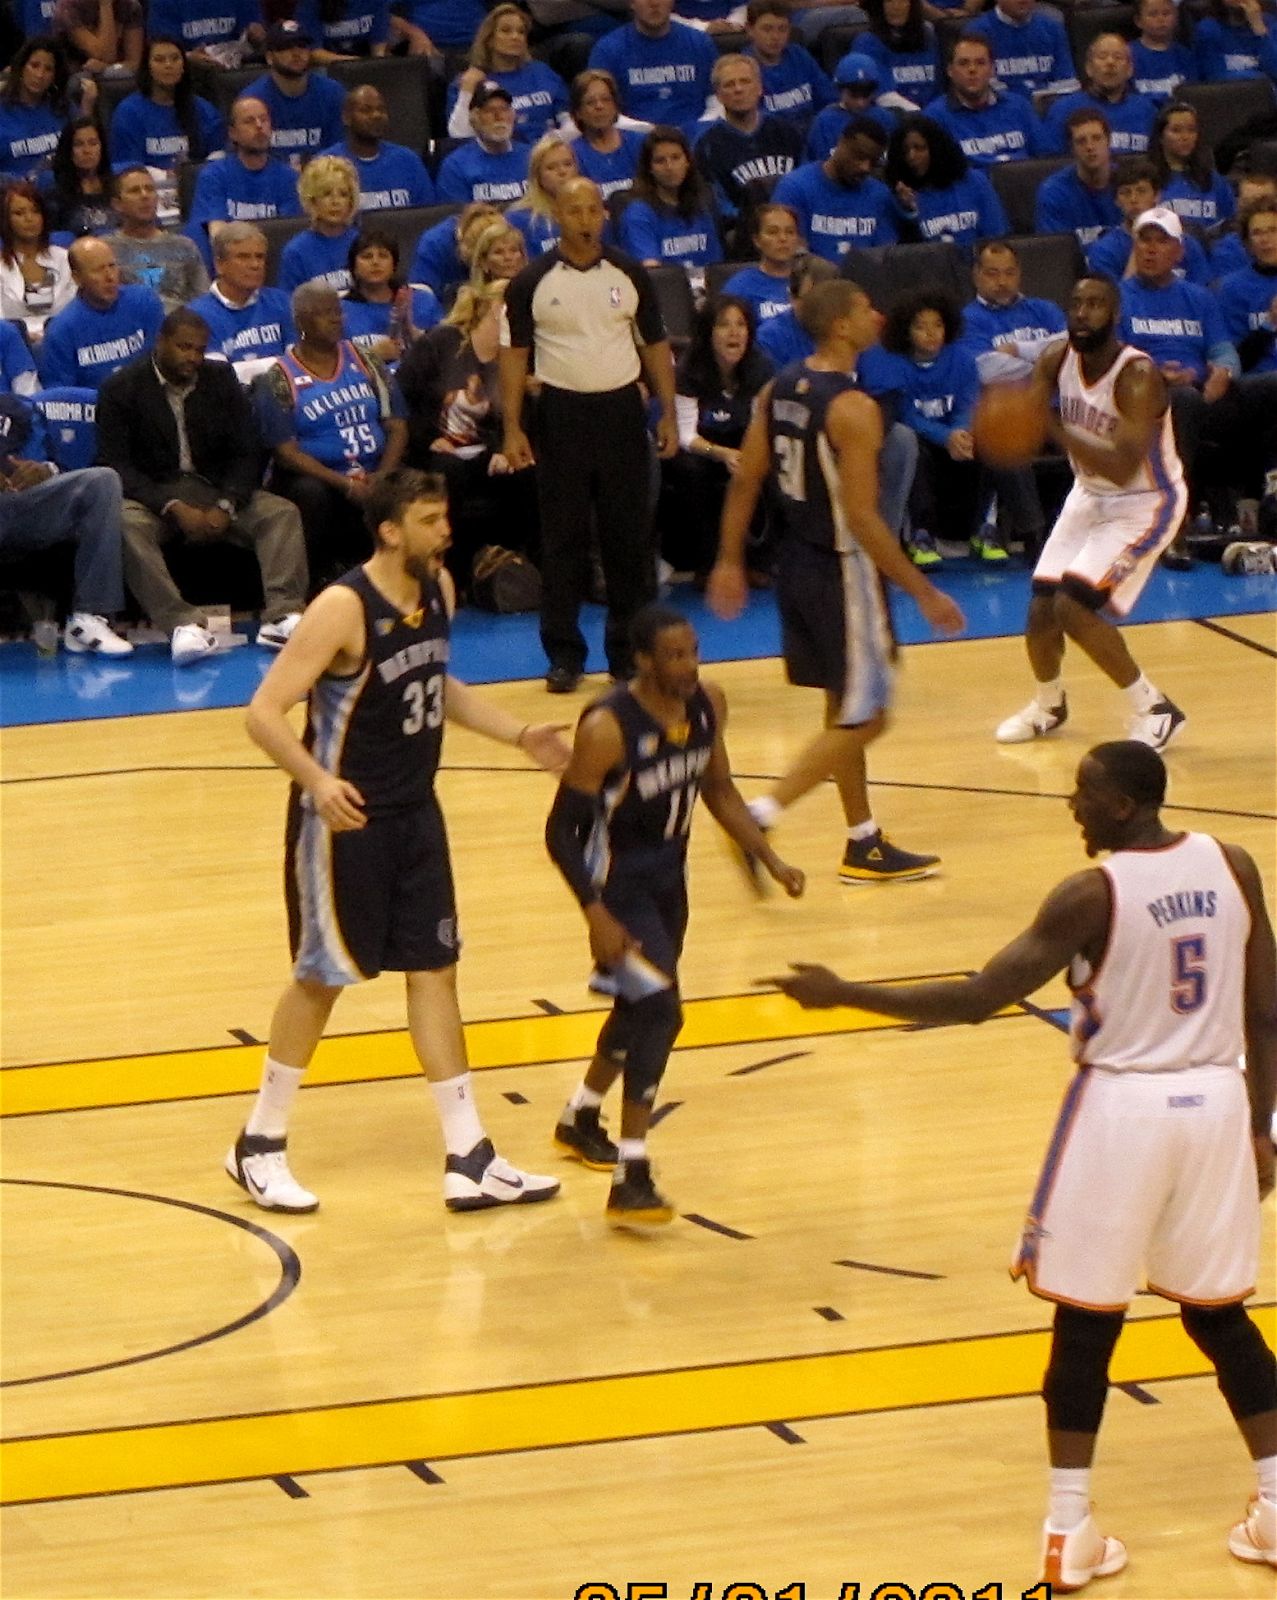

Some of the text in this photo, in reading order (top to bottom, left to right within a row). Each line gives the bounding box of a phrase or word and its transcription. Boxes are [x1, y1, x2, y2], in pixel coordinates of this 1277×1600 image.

[78, 337, 131, 367] OKLAHOMA
[335, 404, 367, 428] CITY
[339, 423, 377, 457] 35
[403, 674, 446, 736] 33
[1146, 890, 1217, 928] PERKINS
[1169, 932, 1208, 1015] 5
